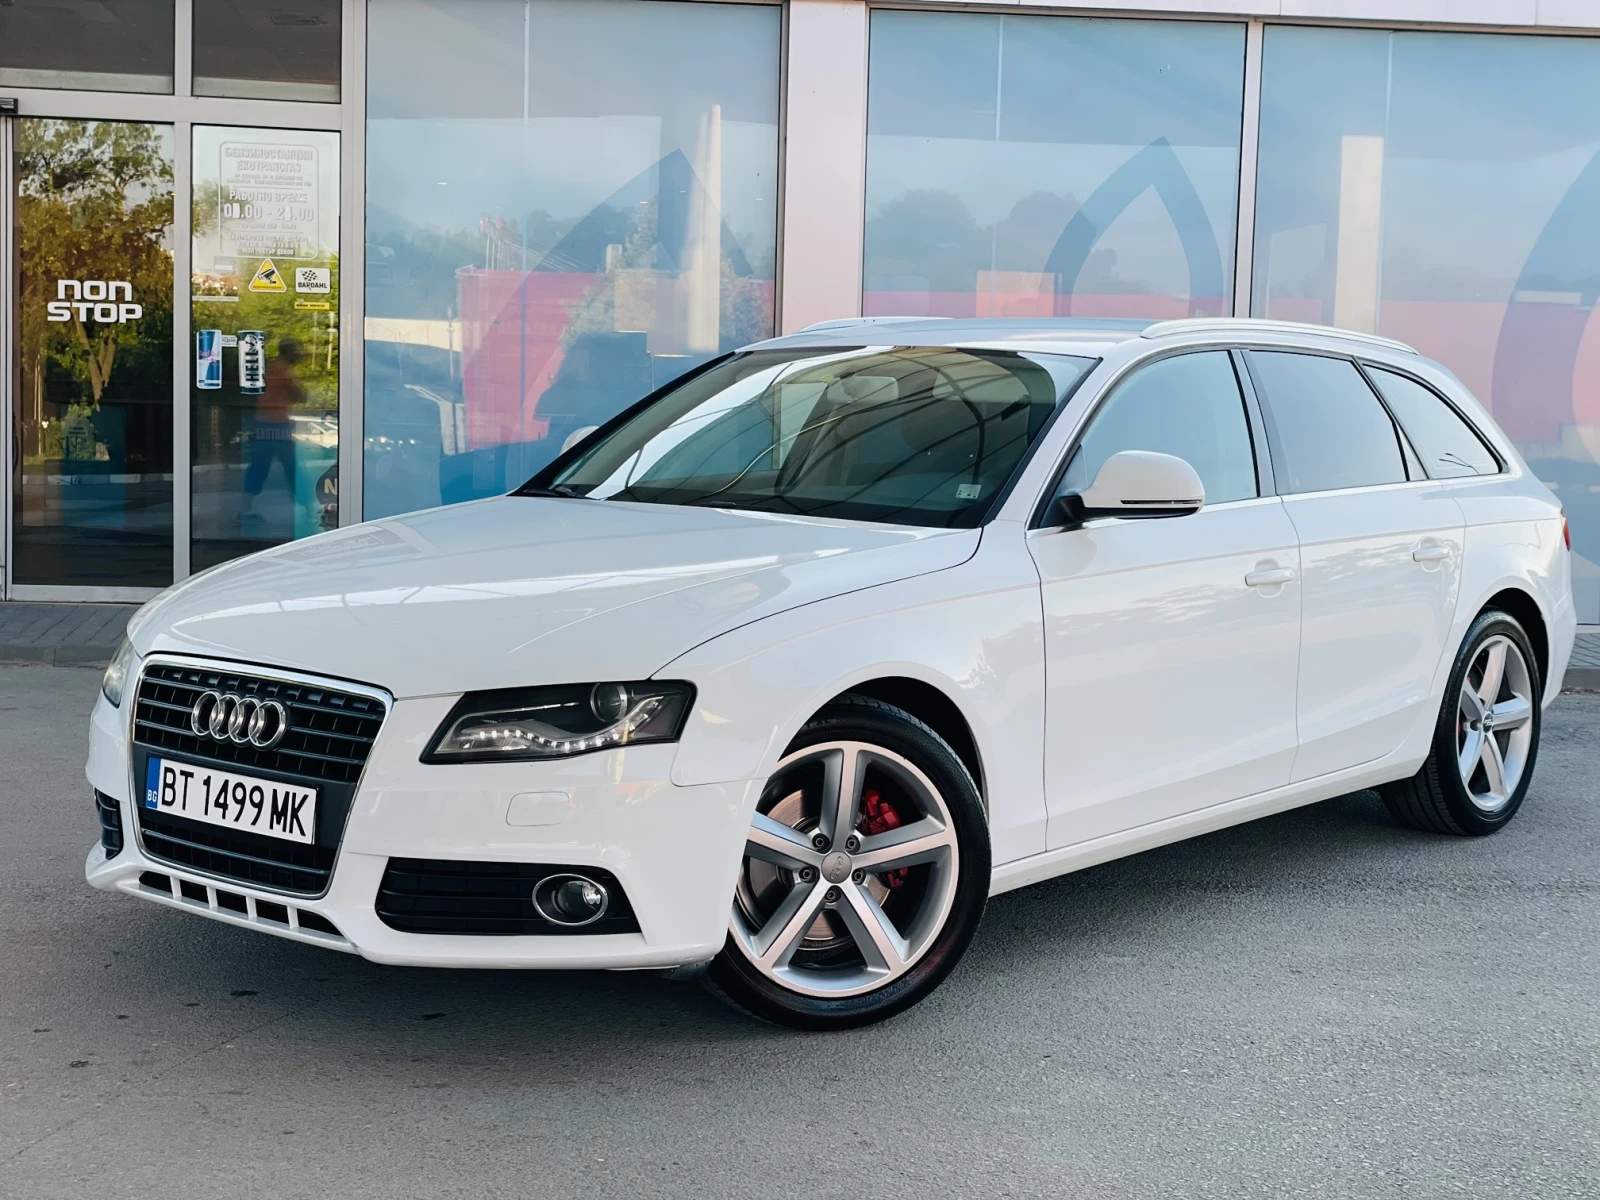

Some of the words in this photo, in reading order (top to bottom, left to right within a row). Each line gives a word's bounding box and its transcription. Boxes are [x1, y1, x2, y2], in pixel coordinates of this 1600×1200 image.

[229, 190, 272, 202] РАБОТНО
[275, 192, 308, 204] ВРЕМЕ
[224, 203, 262, 219] 0.00
[298, 282, 328, 290] BARDAHL
[47, 301, 143, 324] STOP
[245, 350, 259, 381] HELL
[147, 789, 158, 803] BG
[161, 766, 195, 811] BT
[202, 775, 265, 826] 1499
[269, 788, 310, 837] MK
